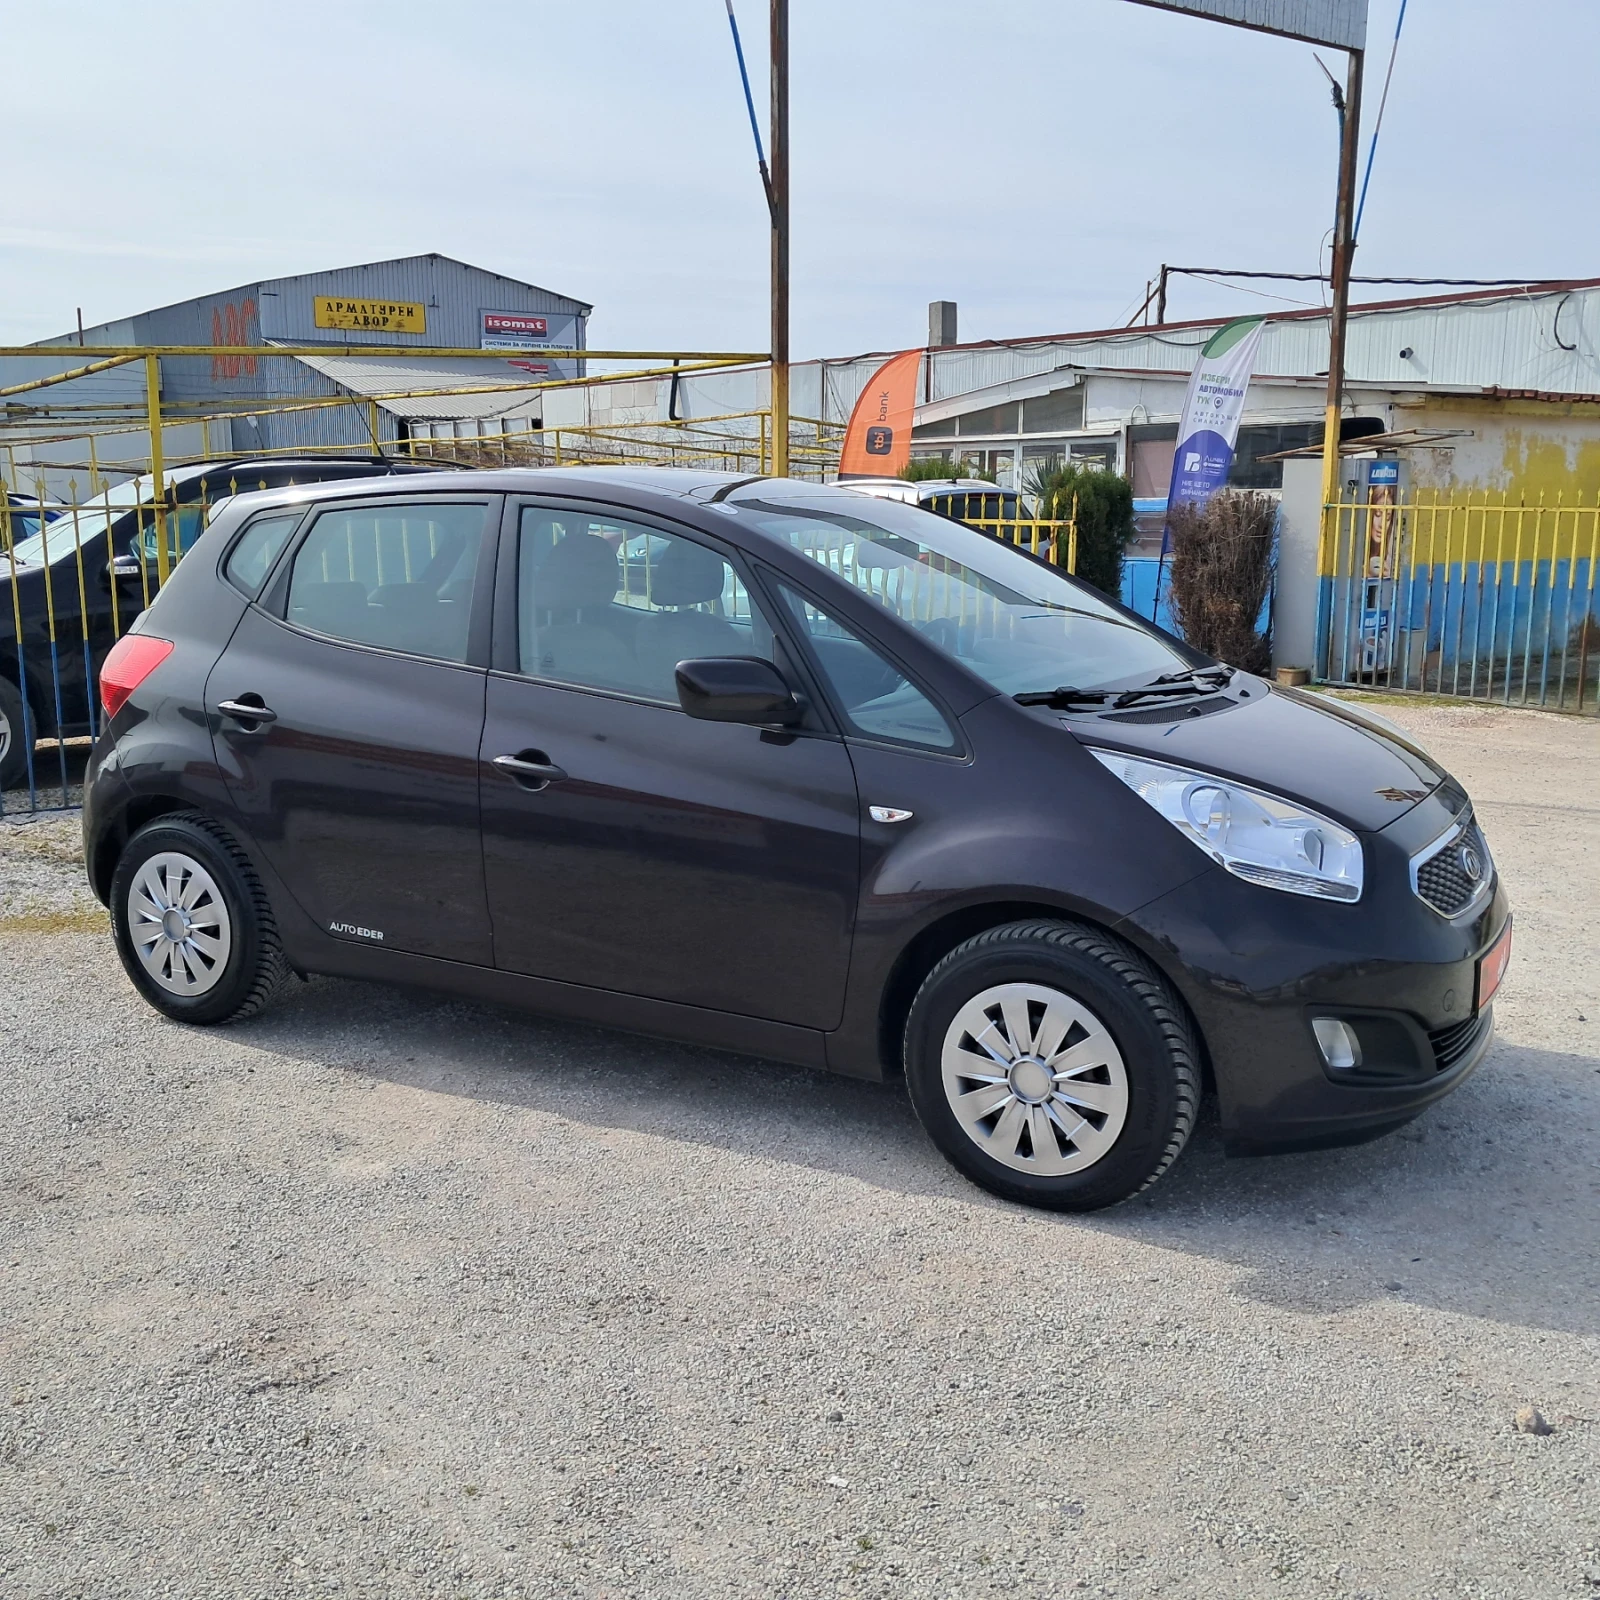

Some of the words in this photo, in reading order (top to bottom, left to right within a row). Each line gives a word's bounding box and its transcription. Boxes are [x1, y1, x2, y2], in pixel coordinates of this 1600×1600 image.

[326, 302, 414, 317] АРМАТУРЕН
[353, 315, 389, 327] ДВОР
[488, 317, 544, 330] isomat
[1201, 373, 1231, 385] ИЗБЕРИ
[1199, 384, 1244, 398] АВТОМОБИЛ
[876, 391, 890, 422] bank
[1197, 396, 1210, 405] ТУК
[874, 431, 885, 450] tbi
